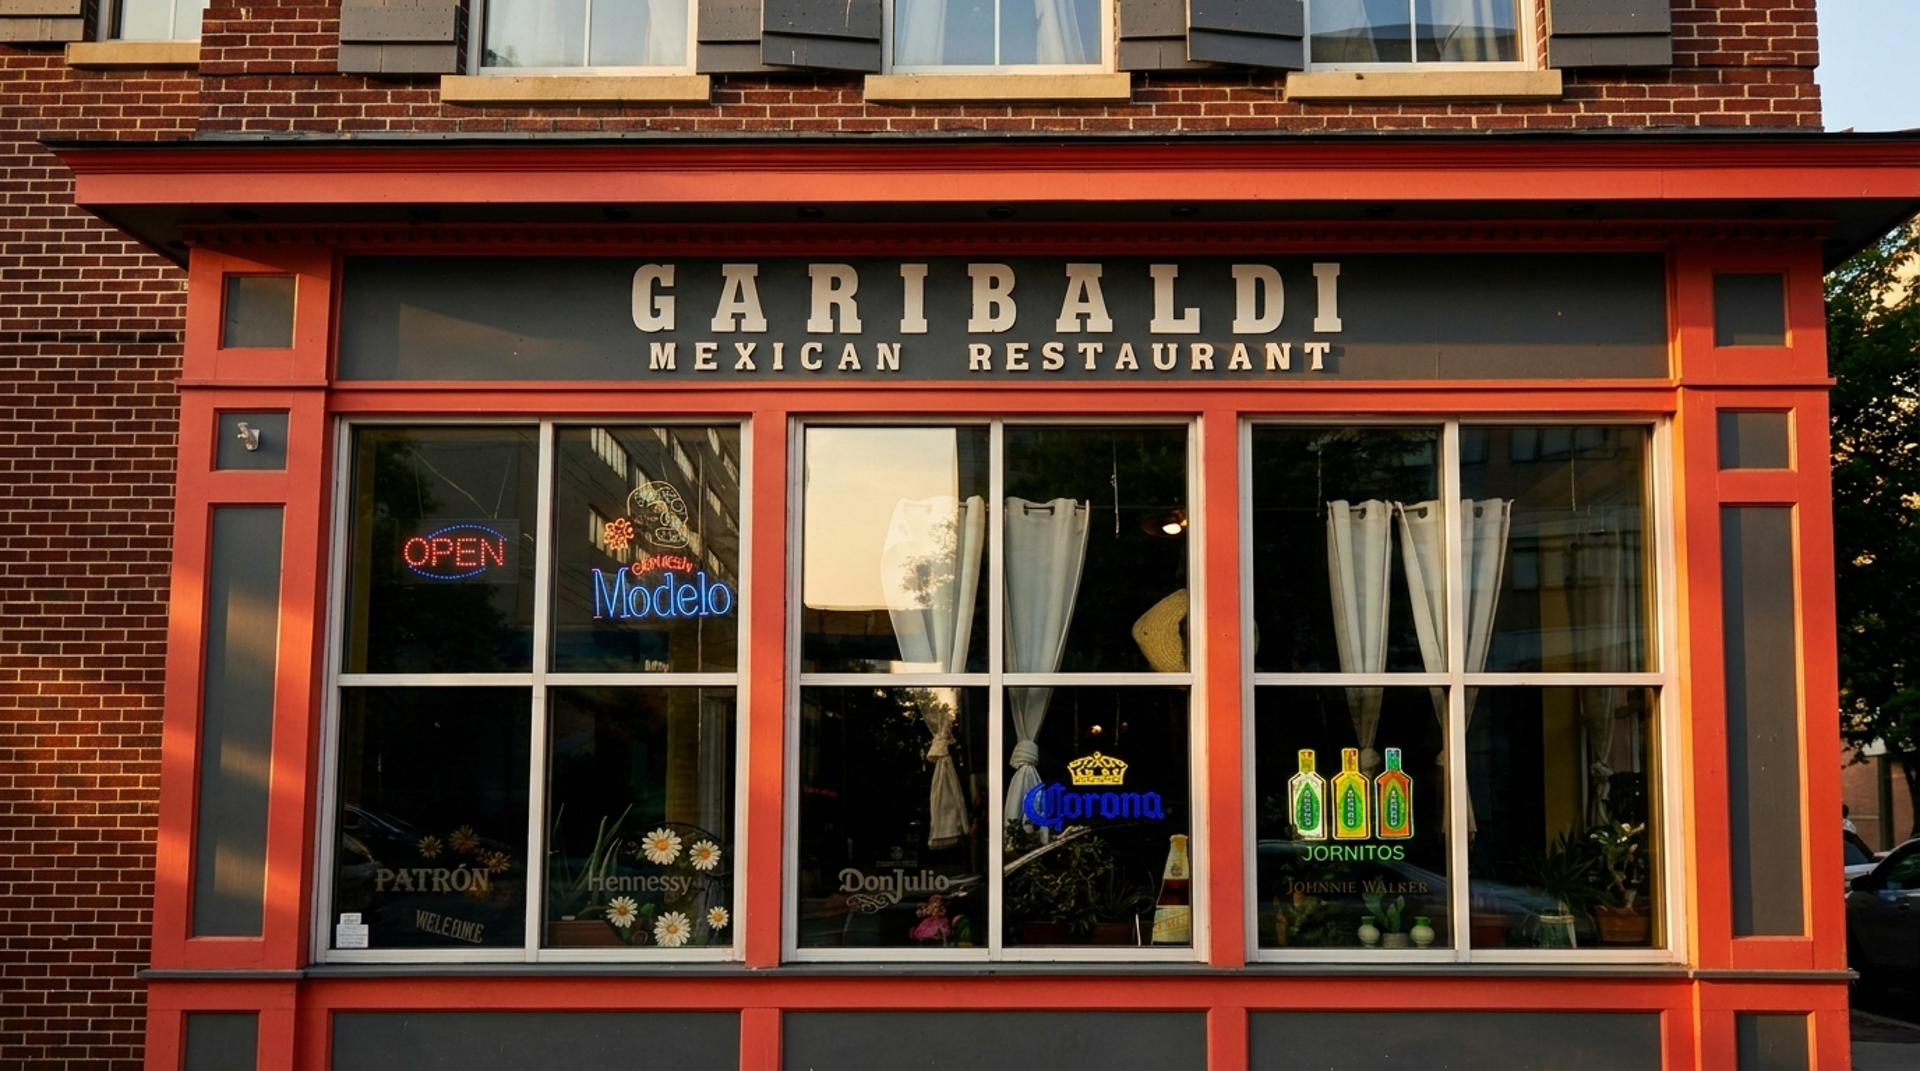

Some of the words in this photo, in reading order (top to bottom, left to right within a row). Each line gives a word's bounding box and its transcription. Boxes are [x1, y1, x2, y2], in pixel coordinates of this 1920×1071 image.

[631, 263, 1343, 334] GARIBALDI
[648, 342, 902, 372] MEXICAN
[968, 342, 1332, 372] RESTAURANT
[403, 536, 506, 567] OPEN
[592, 568, 732, 619] Modelo
[1024, 782, 1165, 831] Corona
[1302, 844, 1405, 863] JORNITOS
[374, 864, 490, 893] PATRÓN
[587, 870, 693, 896] Hennessy
[1287, 879, 1357, 895] JOHNNIE
